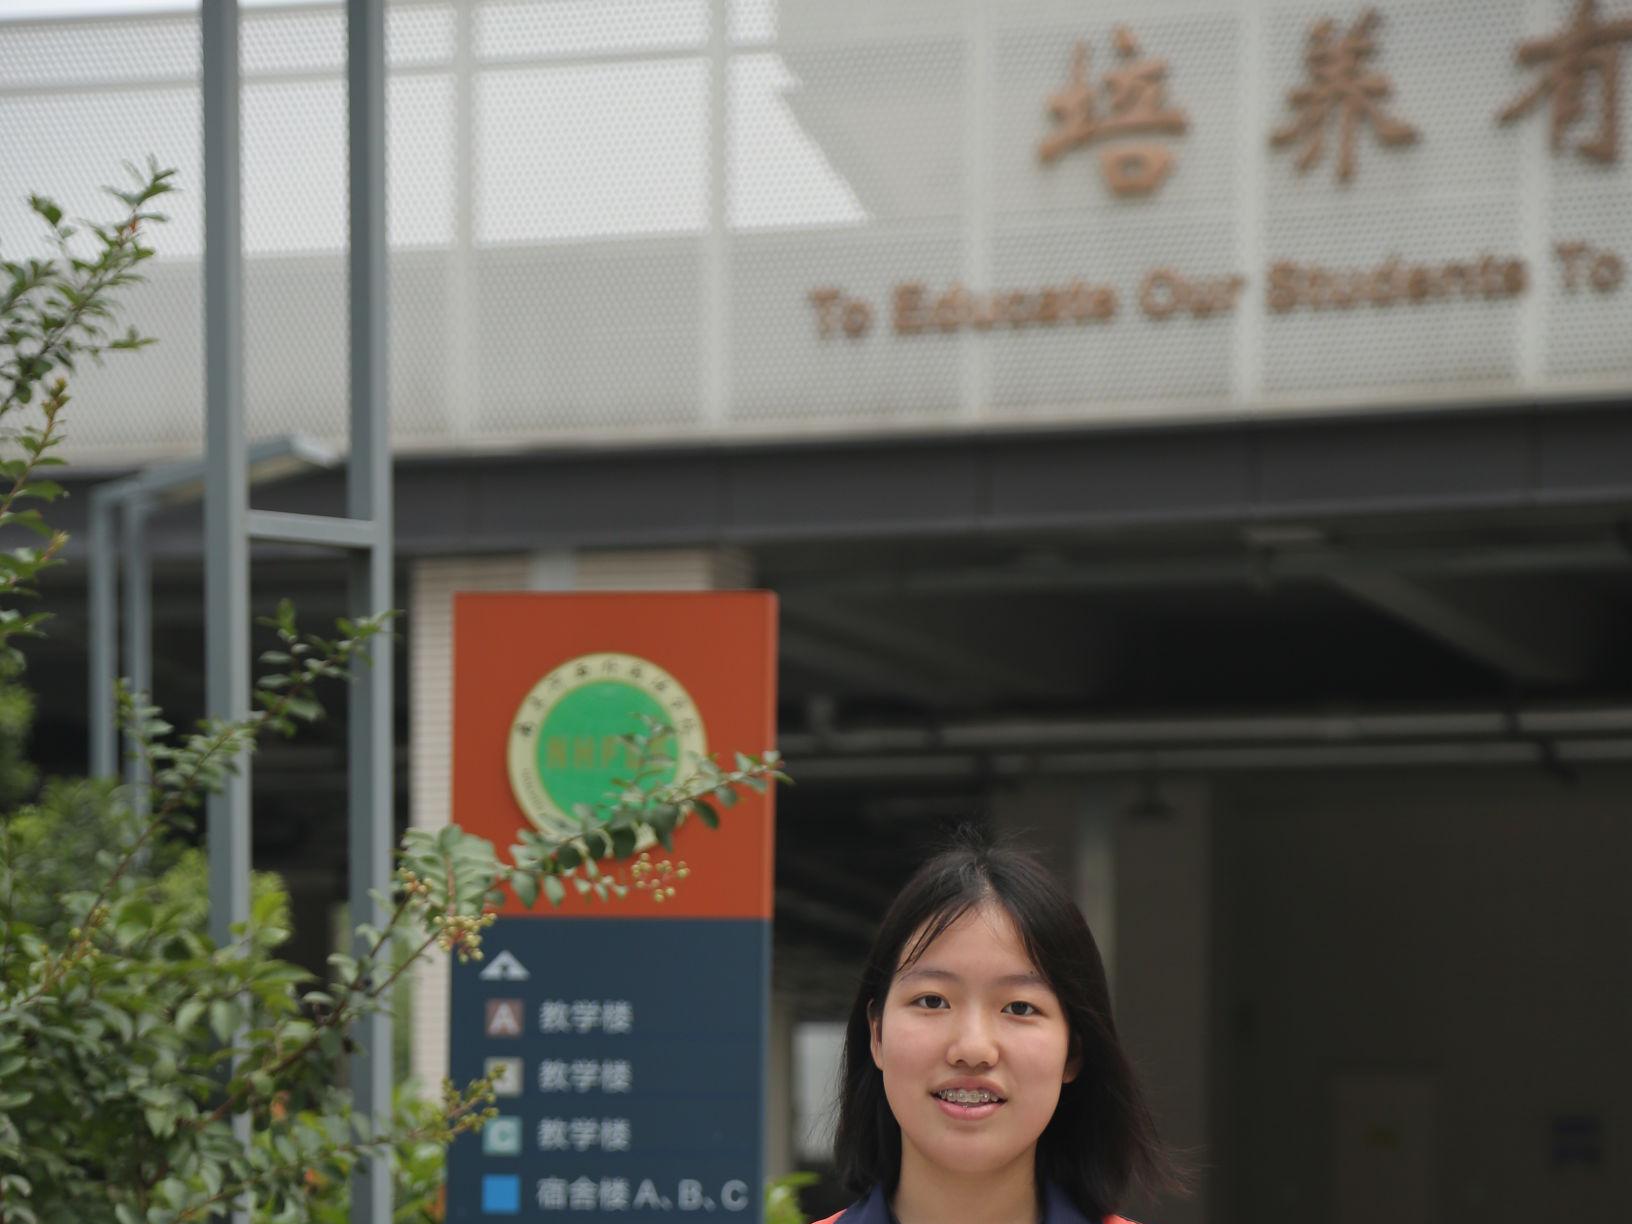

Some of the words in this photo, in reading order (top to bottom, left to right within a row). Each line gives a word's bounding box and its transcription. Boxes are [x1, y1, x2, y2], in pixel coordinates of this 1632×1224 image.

[538, 998, 634, 1034] 教学楼
[537, 1057, 633, 1093] 教学楼
[536, 1116, 632, 1152] 教学楼
